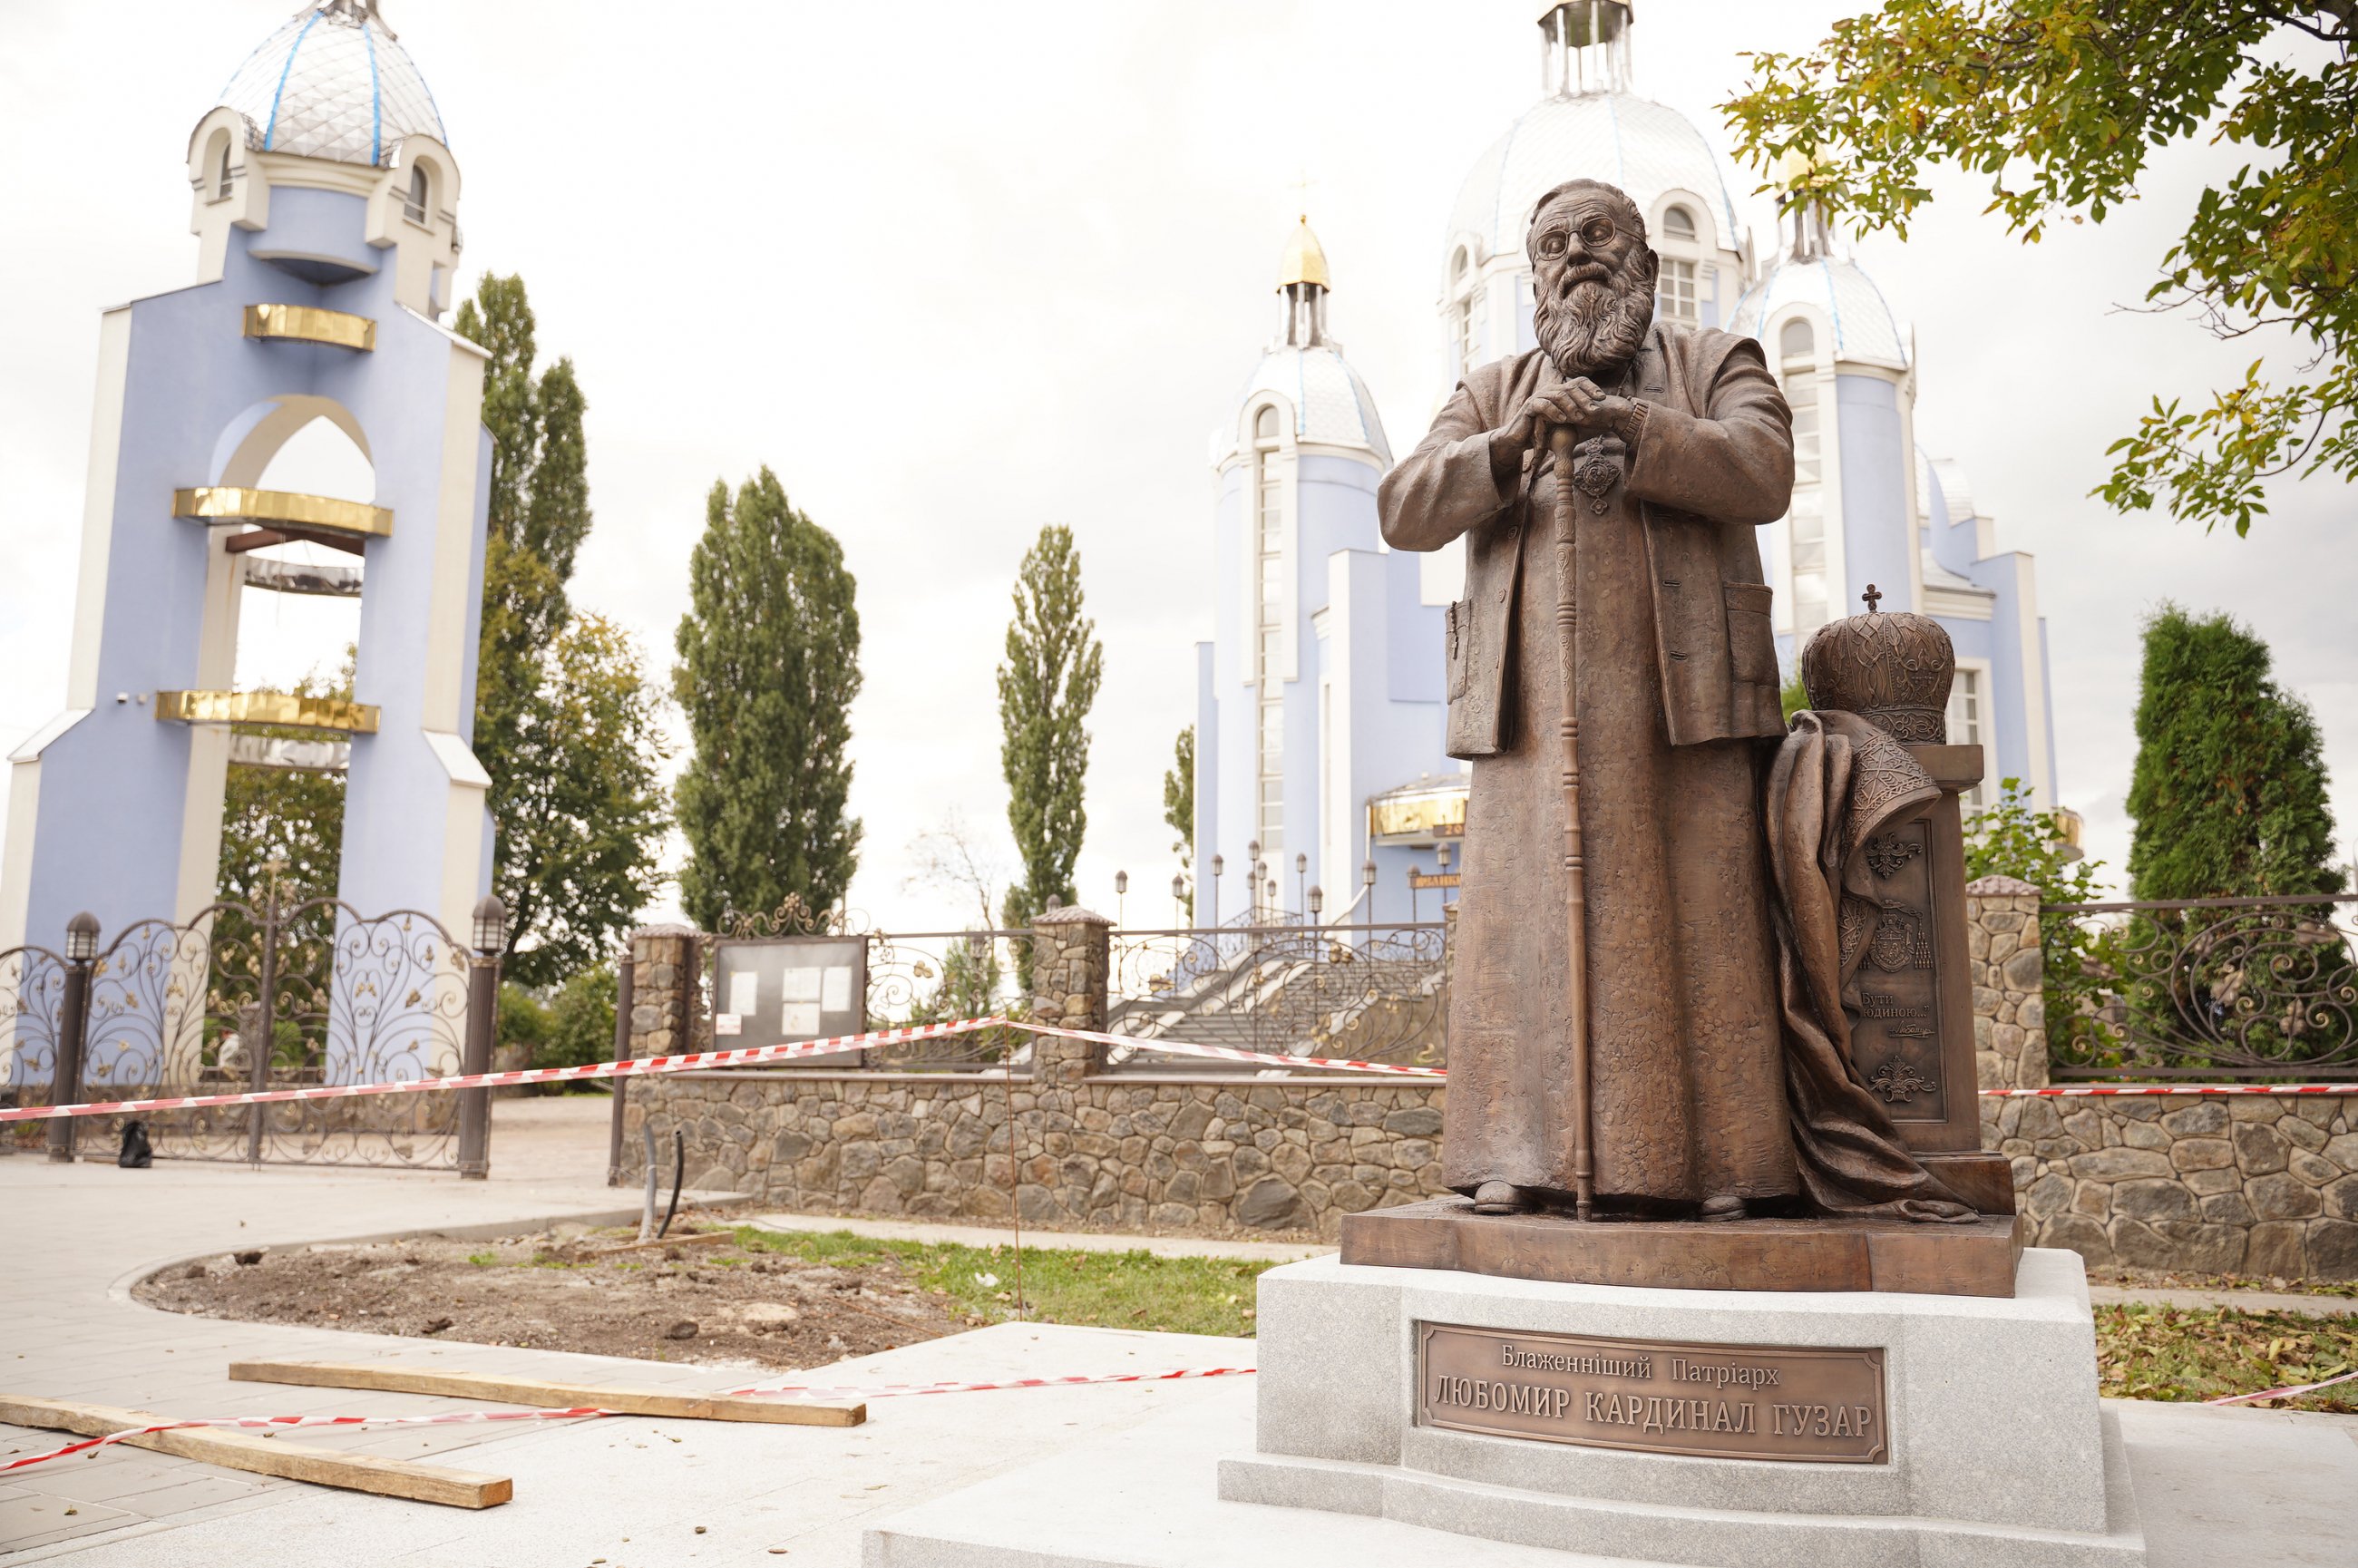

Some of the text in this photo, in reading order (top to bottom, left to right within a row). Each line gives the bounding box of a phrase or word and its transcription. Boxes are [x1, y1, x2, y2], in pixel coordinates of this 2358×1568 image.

[1862, 992, 1893, 1008] Бути
[1502, 1344, 1779, 1391] Блаженніший Патріарх
[1433, 1375, 1873, 1437] ЛЮБОМИР КАРДИНАЛ ГУЗАР
